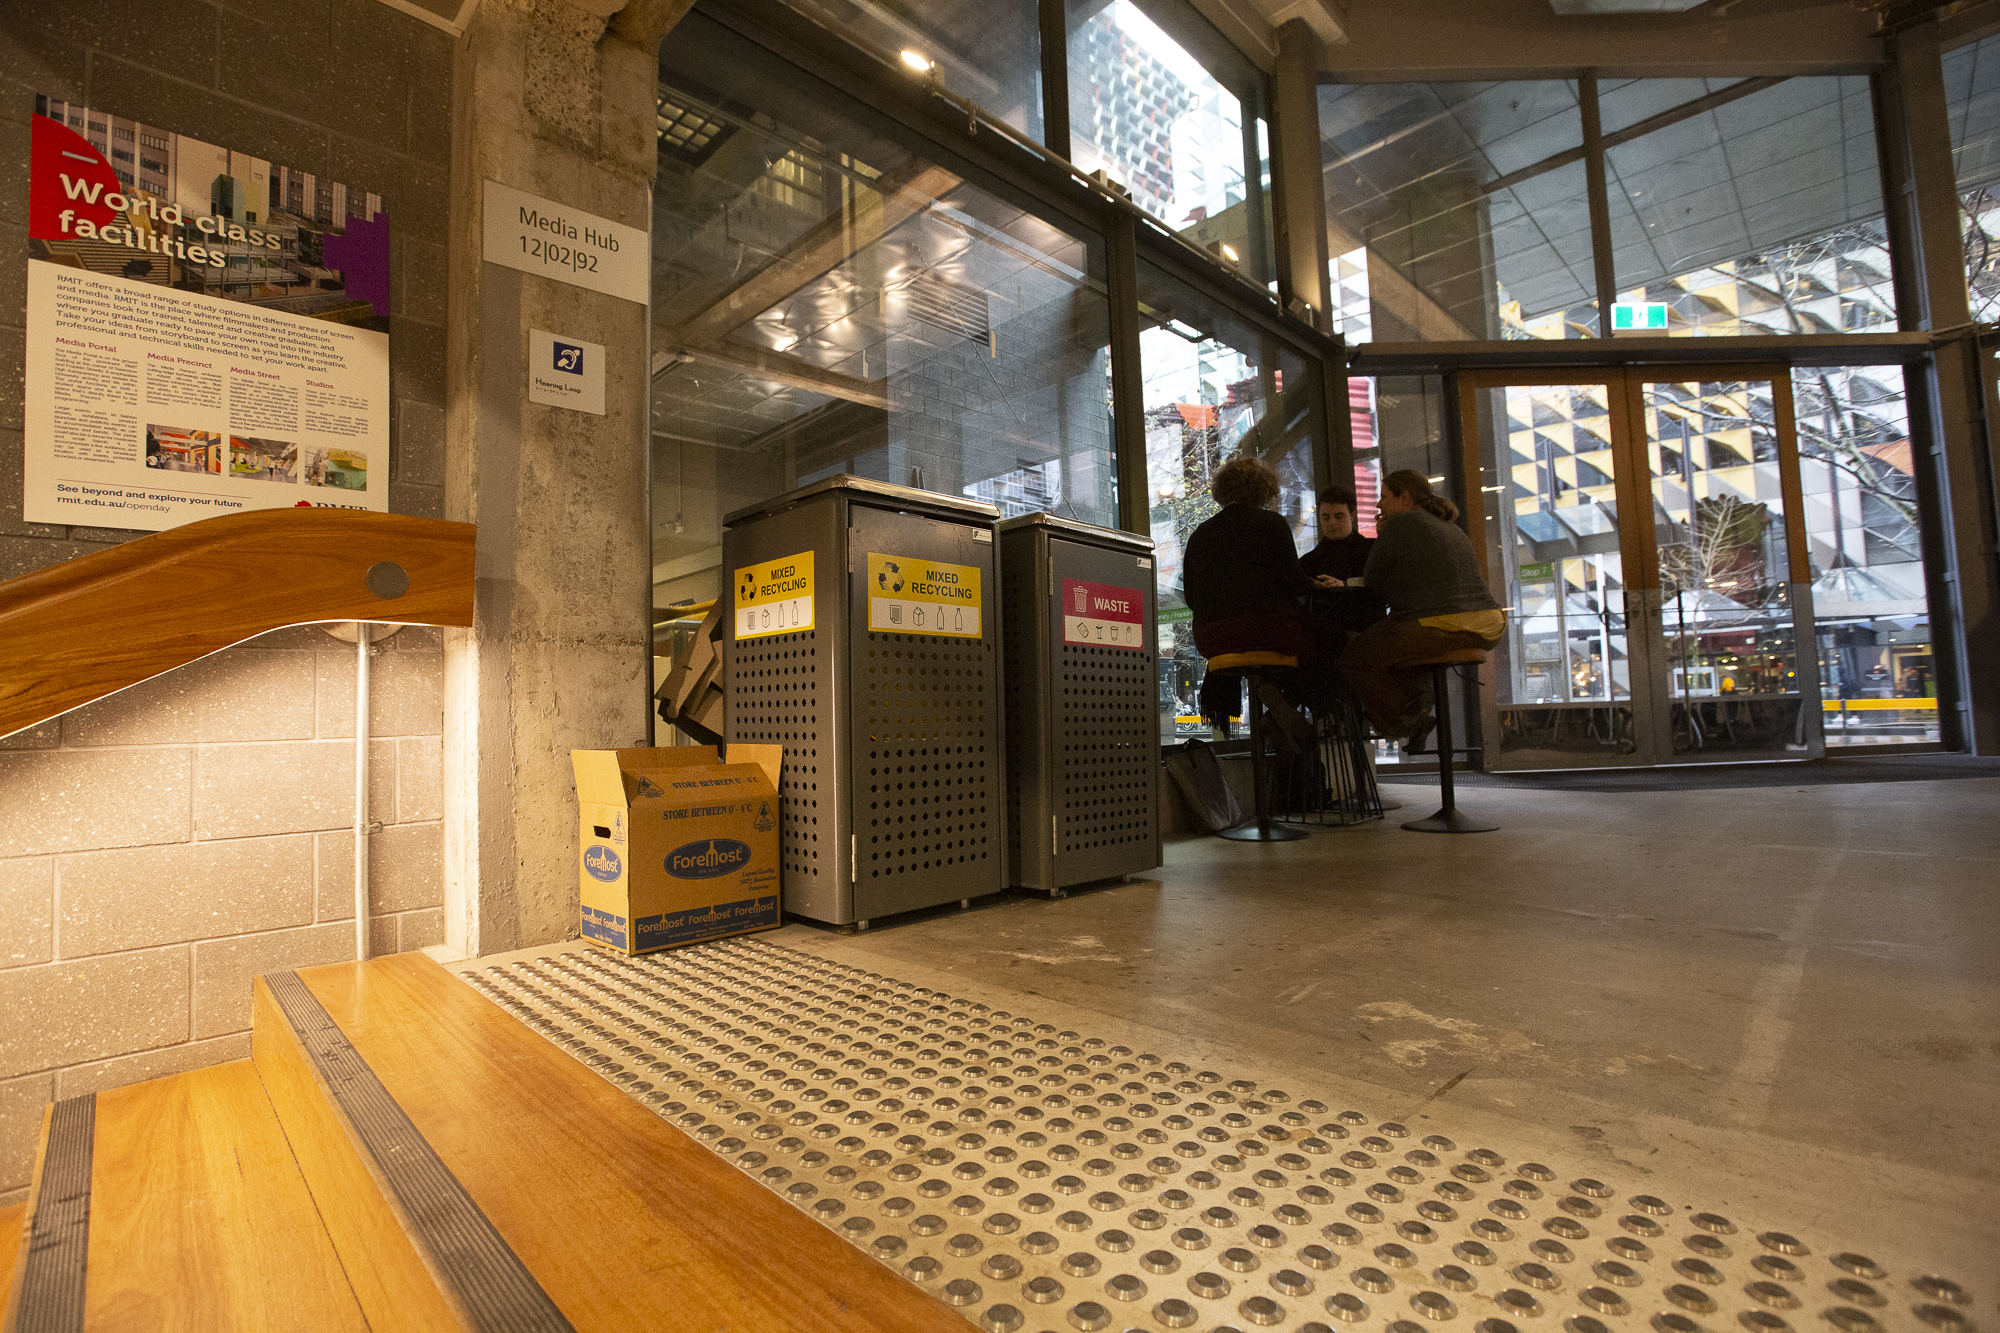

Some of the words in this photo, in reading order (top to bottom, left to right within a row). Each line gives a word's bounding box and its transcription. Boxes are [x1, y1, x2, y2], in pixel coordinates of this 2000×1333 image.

[59, 173, 184, 227] World
[195, 213, 282, 250] class
[519, 206, 578, 240] Media
[585, 227, 620, 252] Hub
[58, 209, 227, 269] facilities
[519, 235, 599, 273] 12|02|92
[56, 284, 76, 293] and
[78, 289, 111, 300] media.
[114, 294, 139, 305] RMIT
[150, 302, 166, 311] the
[167, 306, 192, 316] place
[193, 311, 221, 322] where
[223, 316, 269, 331] filmmakers
[270, 327, 286, 335] and
[287, 330, 331, 344] production
[57, 274, 83, 285] RMIT
[85, 281, 113, 292] offers
[123, 288, 152, 300] broad
[153, 295, 180, 305] range
[193, 303, 217, 314] study
[218, 308, 251, 320] options
[262, 317, 297, 329] different
[298, 325, 319, 334] areas
[329, 331, 355, 341] screen
[56, 293, 111, 308] companies
[113, 303, 134, 313] look
[136, 307, 150, 316] for
[151, 311, 186, 323] trained,
[188, 318, 224, 330] talented
[225, 326, 243, 334] and
[243, 329, 277, 341] creative
[278, 336, 318, 349] graduates,
[320, 344, 335, 352] and
[56, 302, 88, 313] where
[90, 308, 109, 317] you
[111, 312, 154, 325] graduate
[156, 321, 182, 331] ready
[195, 328, 216, 337] pave
[217, 332, 238, 341] your
[239, 337, 259, 345] own
[259, 340, 279, 349] road
[280, 344, 297, 352] into
[298, 347, 311, 355] the
[312, 350, 346, 362] industry.
[56, 309, 81, 320] Take
[83, 316, 106, 325] your
[108, 320, 134, 330] ideas
[135, 324, 158, 335] from
[160, 330, 209, 344] storyboard
[210, 338, 220, 346] to
[221, 341, 250, 351] screen
[262, 349, 278, 357] you
[279, 351, 301, 361] learn
[301, 355, 315, 363] the
[316, 359, 348, 370] creative,
[55, 336, 86, 348] Media
[88, 342, 117, 353] Portal
[56, 320, 116, 336] professional
[118, 331, 137, 339] and
[138, 334, 181, 347] technical
[183, 342, 205, 351] skills
[206, 346, 239, 357] needed
[264, 357, 284, 365] your
[285, 361, 306, 370] work
[307, 365, 329, 373] apart.
[146, 352, 175, 363] Media
[176, 357, 213, 369] Precinct
[230, 366, 256, 377] Media
[256, 370, 281, 381] Street
[305, 379, 334, 390] Studios
[535, 377, 563, 391] Hearing
[564, 381, 582, 394] Loop
[57, 483, 79, 493] See
[81, 486, 123, 497] beyond
[125, 491, 146, 499] and
[148, 494, 187, 503] explore
[189, 497, 212, 505] your
[213, 498, 243, 508] future
[56, 496, 171, 514] rmit.edu.au/openday
[770, 565, 796, 581] MIXED
[925, 569, 959, 584] MIXED
[1521, 568, 1540, 577] Stop
[1542, 566, 1547, 574] 7
[760, 577, 807, 597] RECYCLING
[911, 581, 972, 599] RECYCLING
[1093, 597, 1130, 614] WASTE
[672, 781, 699, 790] STORE
[699, 777, 735, 788] BETWEEN
[662, 809, 690, 821] STORE
[691, 805, 728, 818] BETWEEN
